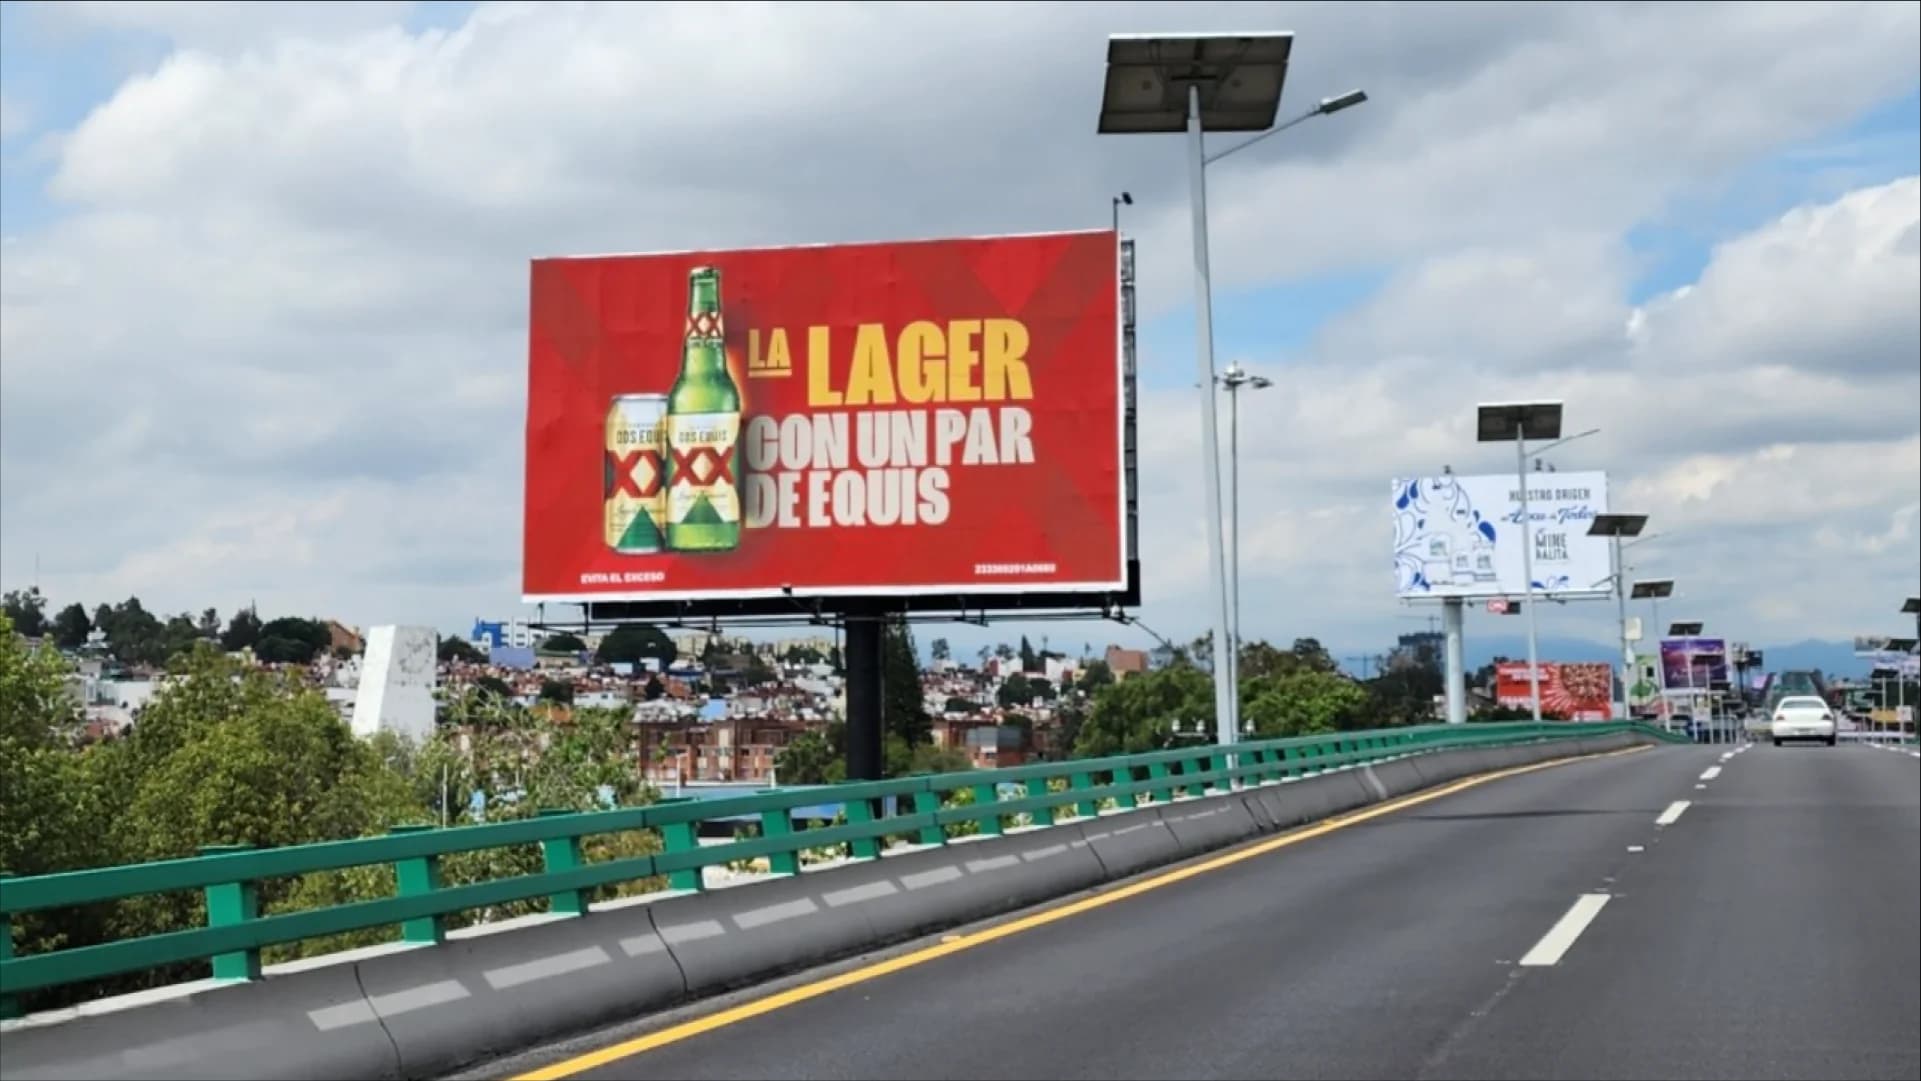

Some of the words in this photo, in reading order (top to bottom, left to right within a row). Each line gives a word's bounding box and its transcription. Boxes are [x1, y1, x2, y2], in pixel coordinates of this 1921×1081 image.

[748, 328, 792, 369] LA
[808, 318, 1033, 407] LAGER
[616, 429, 637, 444] DOS
[746, 411, 849, 471] CON
[856, 409, 928, 468] UN
[935, 406, 1036, 466] PAR
[745, 470, 801, 529] DE
[808, 467, 950, 527] EQUIS
[1508, 488, 1552, 502] NUSTRO
[1555, 487, 1591, 501] ORIGEN
[580, 572, 608, 585] EVITA
[609, 572, 622, 584] EL
[623, 570, 666, 584] EXCESO
